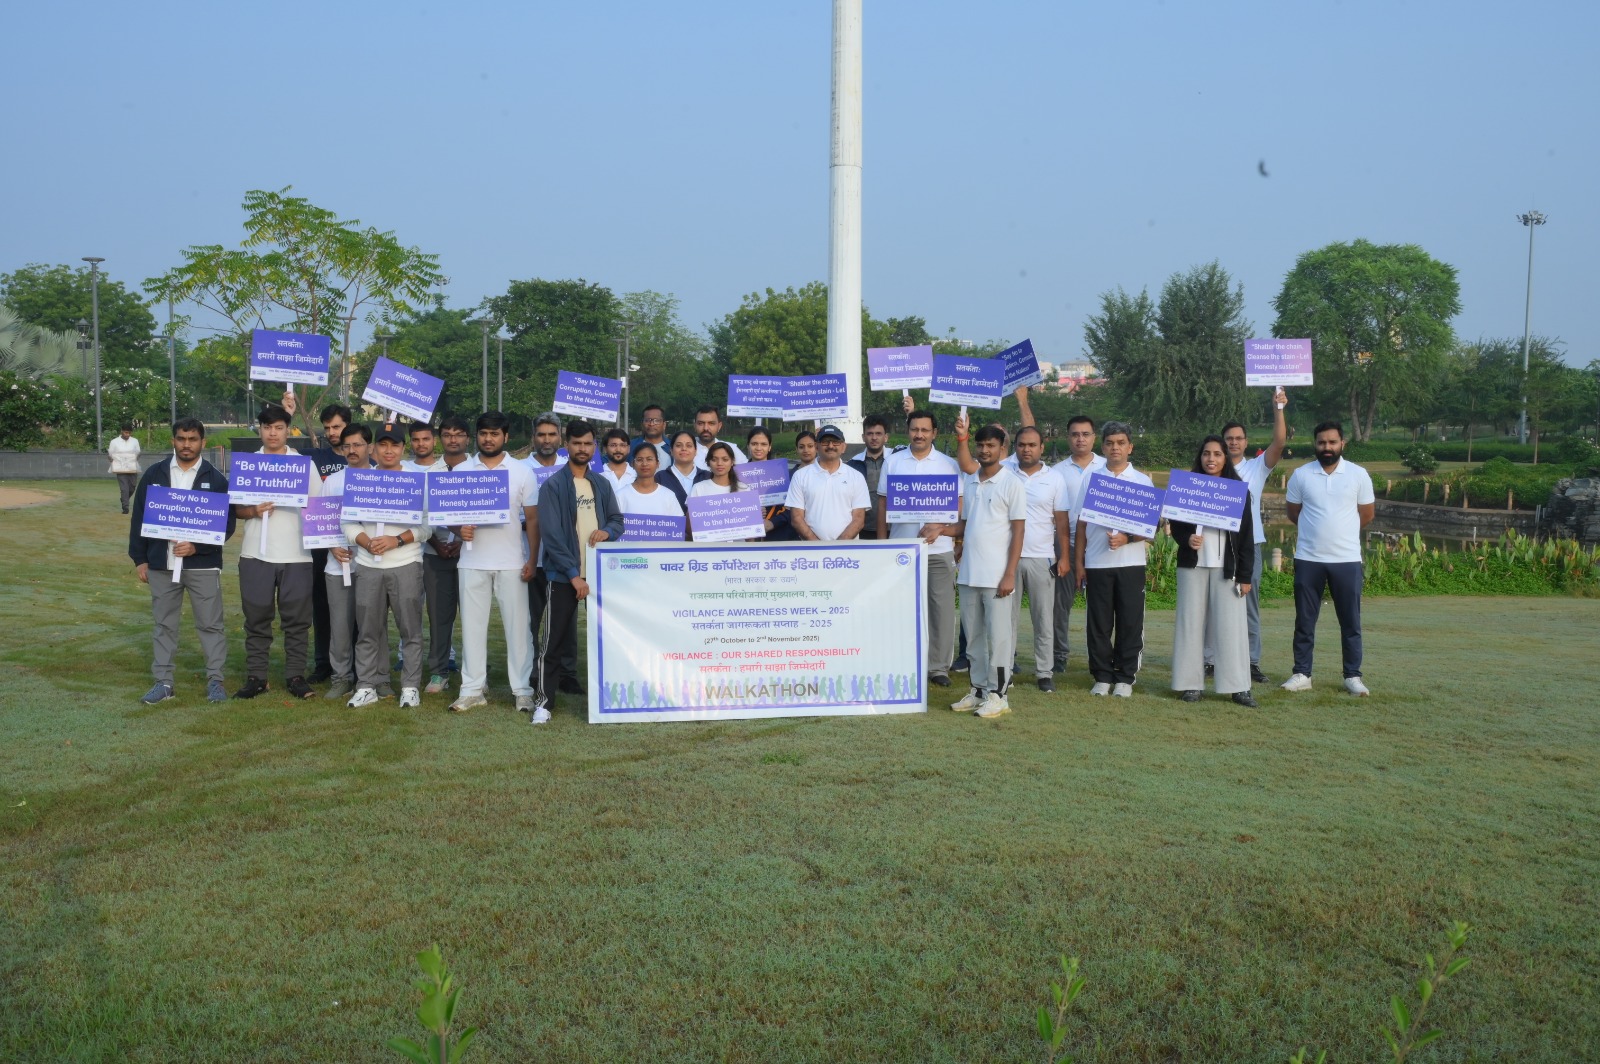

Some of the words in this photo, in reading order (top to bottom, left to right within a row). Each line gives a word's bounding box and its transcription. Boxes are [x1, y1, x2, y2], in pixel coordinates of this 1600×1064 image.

[257, 351, 275, 360] हमारी
[277, 354, 294, 363] साझा
[375, 377, 391, 388] हमारी
[560, 384, 592, 395] Corruption,
[595, 390, 617, 399] Commit
[236, 461, 255, 470] “Be
[258, 462, 306, 473] Watchful
[237, 476, 251, 486] Be
[254, 477, 302, 488] Truthful”
[891, 482, 909, 491] “Be
[912, 482, 954, 491] Watchful
[1190, 477, 1206, 487] “Say
[346, 484, 374, 492] Cleanse
[168, 492, 186, 502] “Say
[1137, 490, 1155, 500] chain,
[1171, 485, 1211, 499] Corruption,
[1214, 493, 1242, 503] Commit
[354, 496, 382, 505] Honesty
[894, 497, 906, 505] Be
[909, 497, 952, 506] Truthful”
[1089, 488, 1114, 499] Cleanse
[1149, 503, 1160, 511] Let
[149, 502, 192, 513] Corruption,
[195, 507, 225, 516] Commit
[692, 509, 730, 517] Corruption,
[732, 505, 758, 513] Commit
[1094, 500, 1121, 513] Honesty
[1202, 501, 1229, 511] Nation”
[183, 517, 212, 526] Nation”
[724, 516, 749, 524] Nation”
[660, 563, 684, 571] पावर
[688, 559, 708, 572] ग्रिड
[712, 560, 760, 571] कॉर्पोरेशन
[764, 559, 786, 570] ऑफ
[790, 558, 818, 570] इंडिया
[823, 557, 860, 569] लिमिटेड
[770, 591, 808, 600] मुख्यालय,
[810, 590, 832, 600] जयपुर
[727, 608, 787, 616] AWARENESS
[692, 620, 723, 630] सतर्कता
[727, 621, 769, 630] जागरूकता
[705, 637, 718, 645] (27th
[663, 652, 713, 660] VIGILANCE
[745, 650, 783, 658] SHARED
[786, 648, 861, 657] RESPONSIBILITY
[699, 663, 730, 673] सतर्कता
[740, 663, 761, 672] हमारी
[789, 661, 825, 671] जिम्मेदारी
[705, 683, 819, 699] WALKATHON
